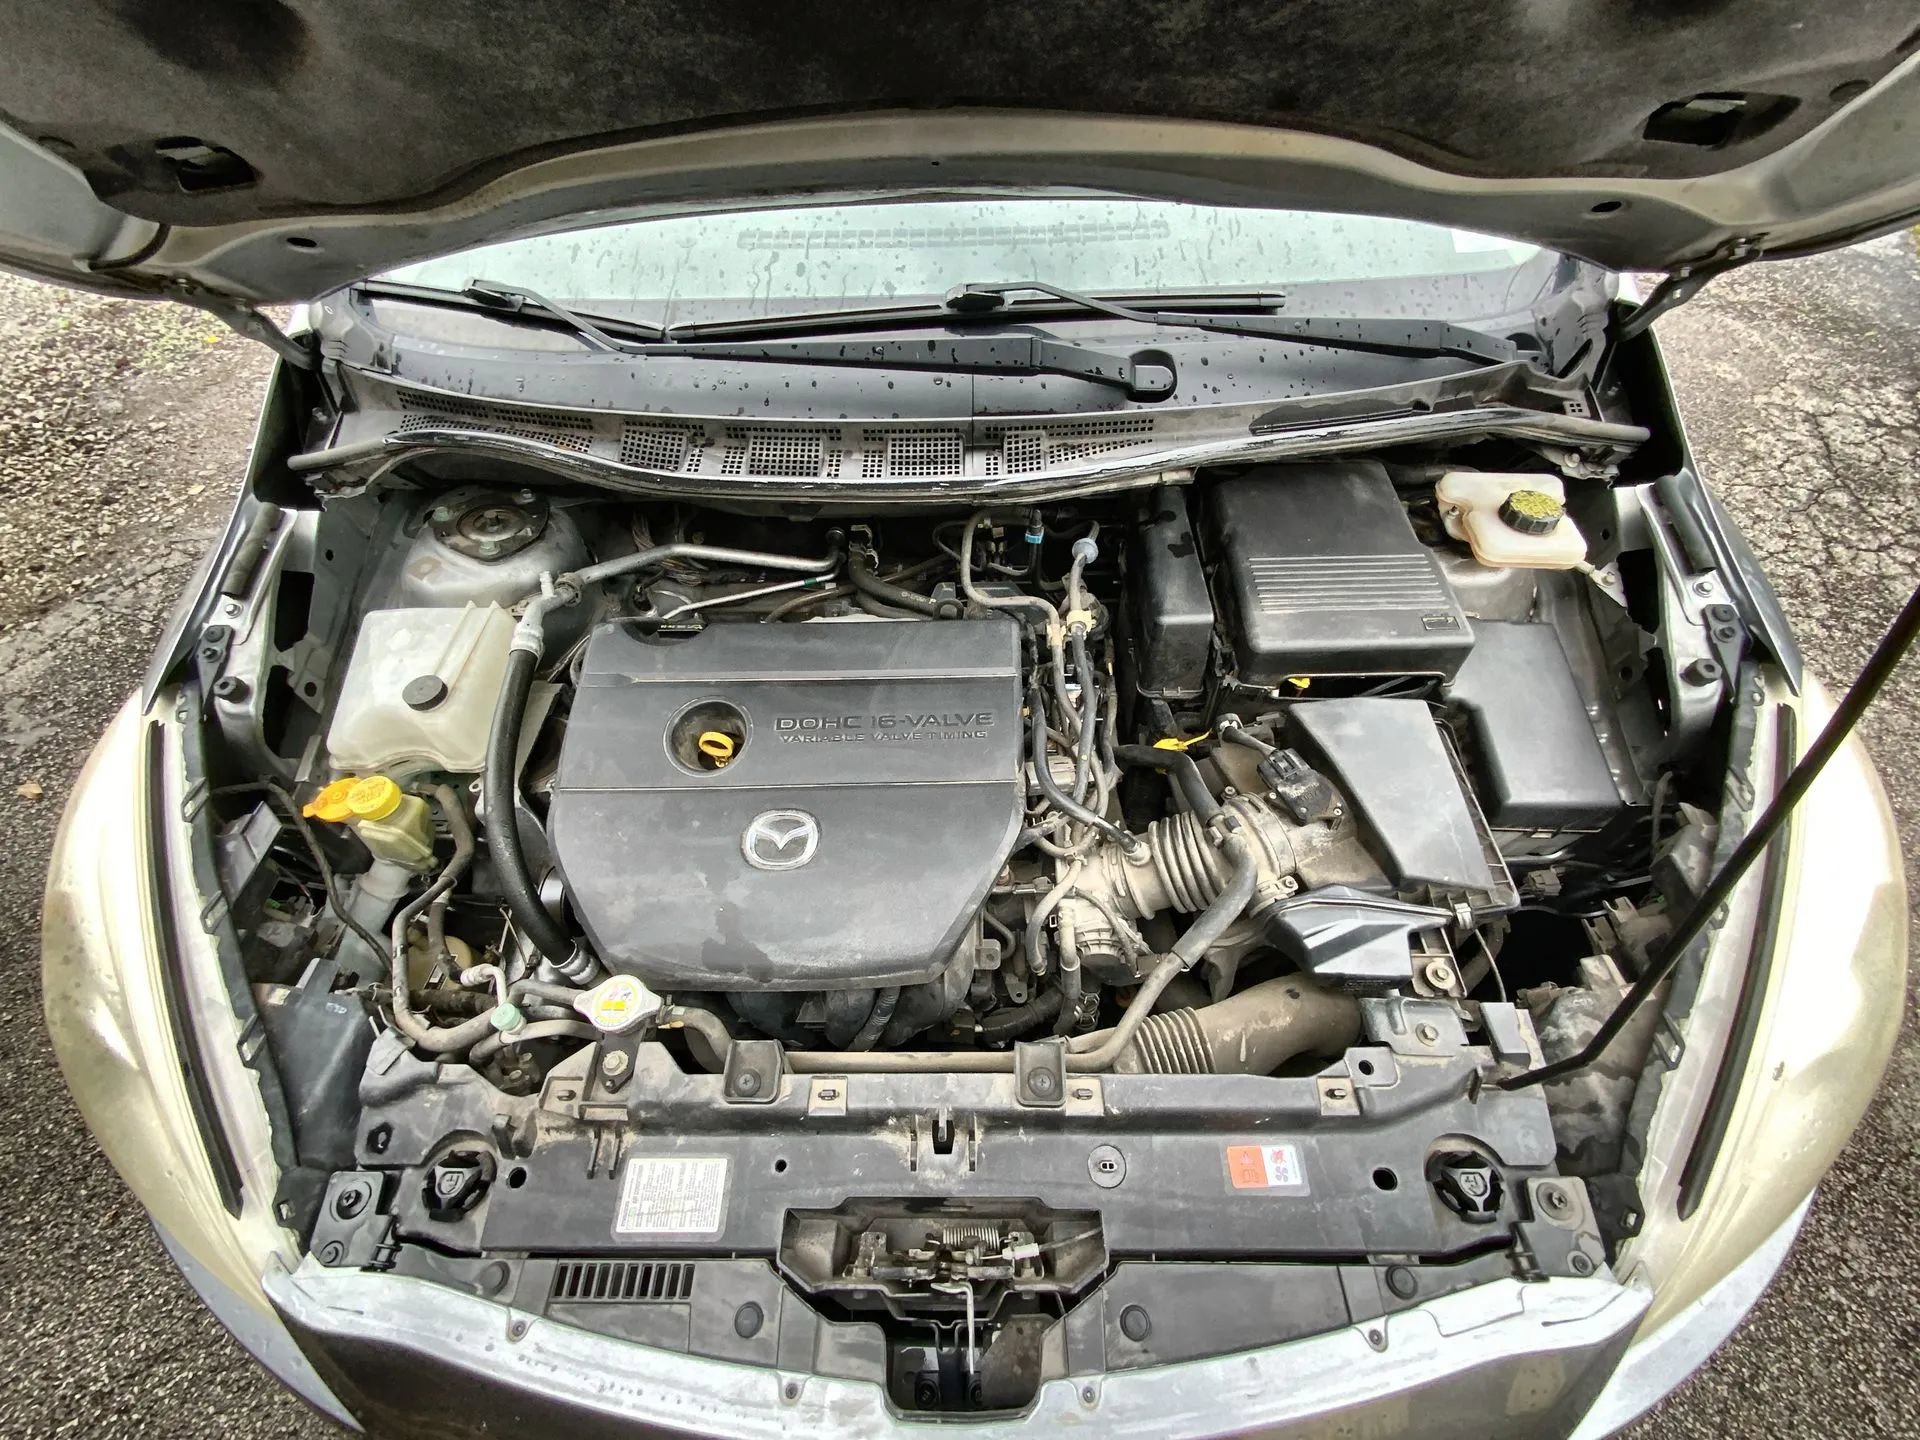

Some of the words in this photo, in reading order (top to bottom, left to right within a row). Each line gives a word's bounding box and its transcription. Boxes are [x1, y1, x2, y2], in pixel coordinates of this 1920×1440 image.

[774, 715, 862, 731] DOHC
[871, 711, 995, 729] 16-VALVE
[780, 733, 865, 744] VARIABLE
[872, 731, 922, 742] VALVE
[927, 730, 988, 741] TIMING
